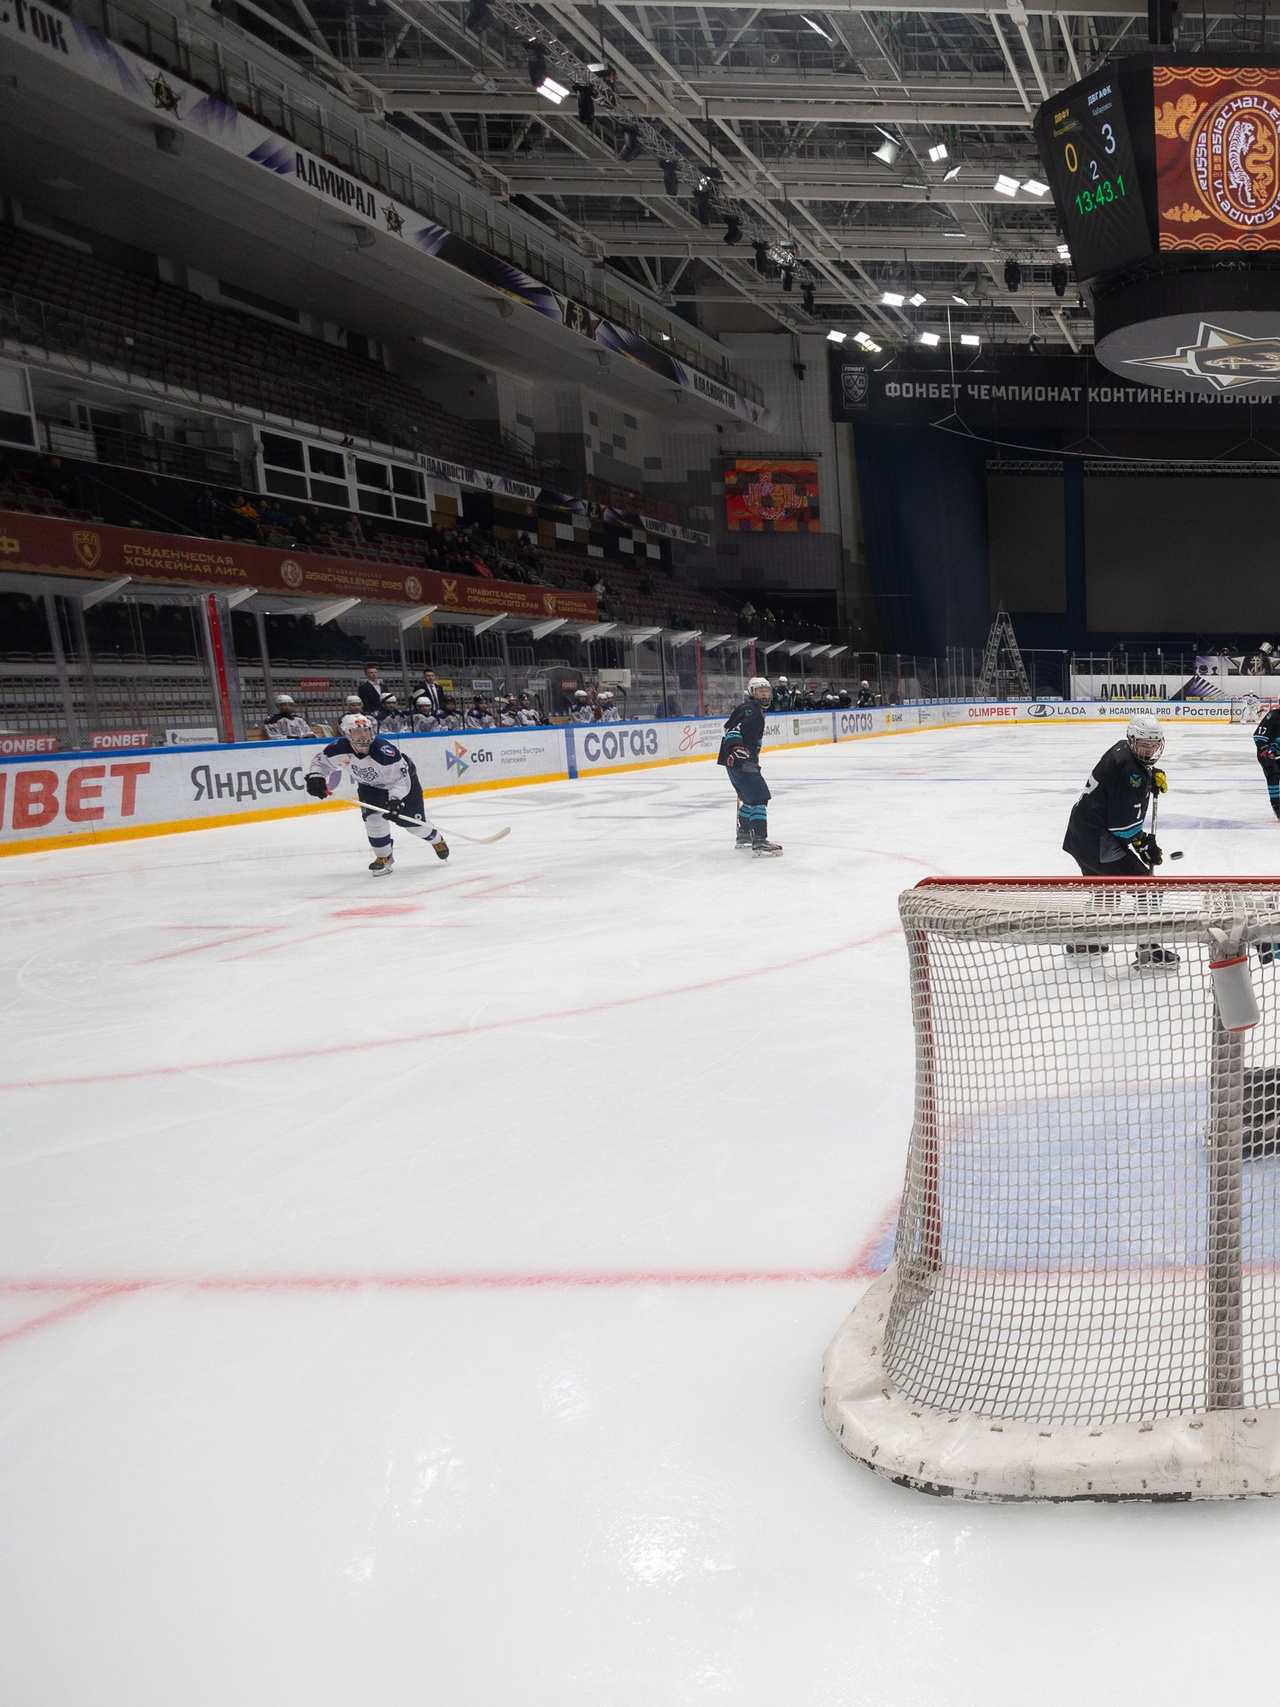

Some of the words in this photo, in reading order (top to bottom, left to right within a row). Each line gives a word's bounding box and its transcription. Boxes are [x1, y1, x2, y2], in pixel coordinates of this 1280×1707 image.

[0, 0, 69, 55] ТОК
[1101, 123, 1116, 154] 3
[1065, 143, 1078, 173] 0
[1089, 160, 1099, 180] 2
[296, 151, 377, 220] АДМИРАЛ
[1075, 174, 1126, 215] 13:43.1
[885, 382, 962, 399] ФОНБЕТ
[967, 384, 1082, 402] ЧЕМПИОНАТ
[123, 544, 234, 565] СТУДЕНЧЕСКАЯ
[124, 556, 212, 573] ХОККЕЙНАЯ
[214, 565, 248, 577] ЛИГА
[466, 587, 527, 600] ПРАВИТЕЛЬСТВО
[467, 596, 521, 608] ПРИМОРСКОГО
[968, 707, 1018, 717] OLIMPBET
[1057, 706, 1087, 715] LADA
[1109, 707, 1171, 715] HCADMIRAL.PRO
[1183, 707, 1243, 716] Ростелеко
[178, 733, 215, 743] Ростелеком
[1257, 726, 1267, 735] 17
[93, 733, 149, 749] FONBET
[471, 749, 493, 763] сбп
[191, 765, 305, 801] Яндекс
[0, 762, 151, 833] BET
[1134, 803, 1142, 819] 7
